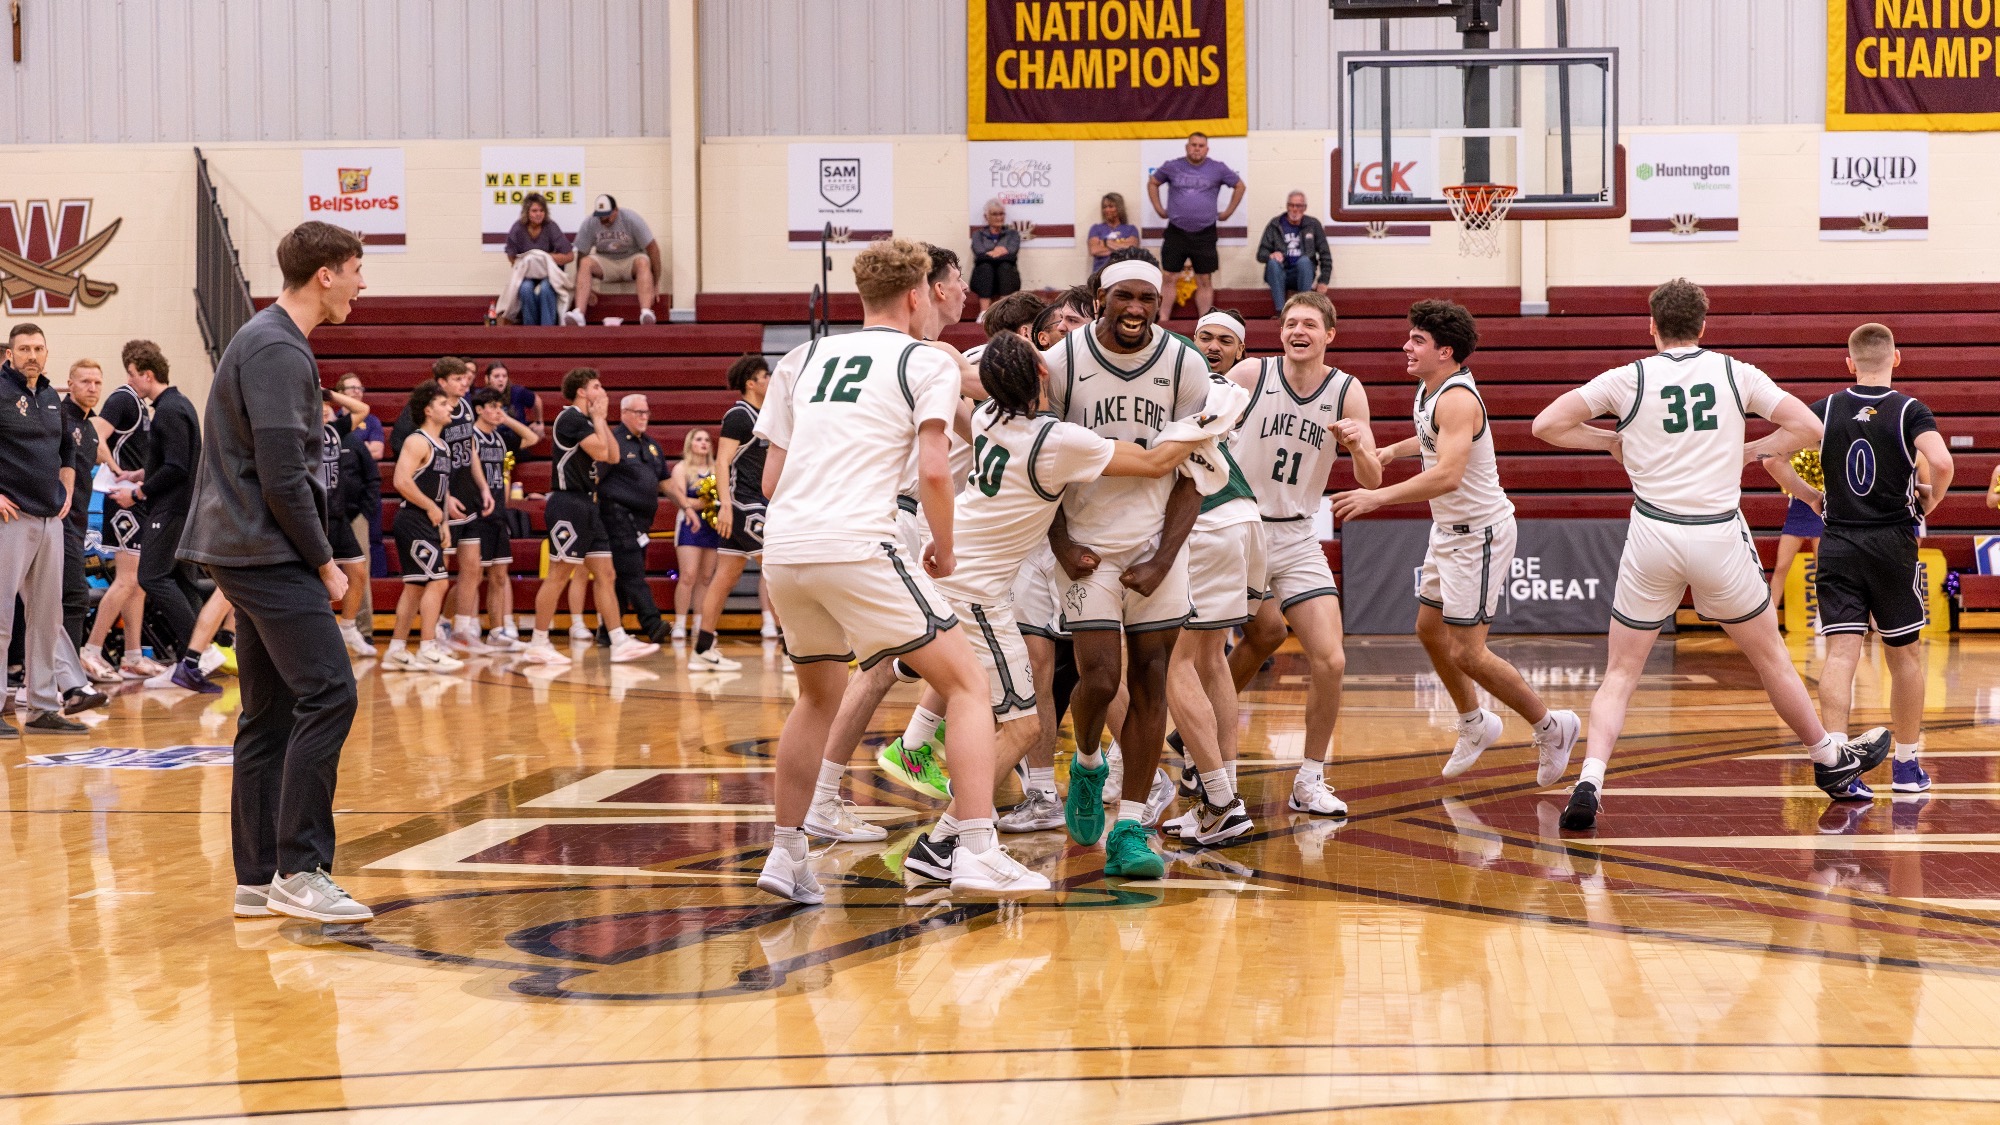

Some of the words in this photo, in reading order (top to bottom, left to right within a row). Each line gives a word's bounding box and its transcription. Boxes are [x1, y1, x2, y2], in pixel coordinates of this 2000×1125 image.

[1015, 0, 1200, 42] NATIONAL
[1875, 0, 2000, 29] NATIO
[995, 45, 1220, 89] CHAMPIONS
[486, 174, 579, 185] WAFFLE
[824, 166, 856, 177] SAM
[991, 170, 1051, 188] FLOORS
[1656, 163, 1730, 180] Huntington
[1831, 156, 1916, 187] LIQUID
[495, 191, 572, 203] HOSE
[809, 355, 873, 403] 12
[1084, 396, 1127, 430] LAKE
[1135, 397, 1166, 432] ERIE
[1660, 383, 1718, 434] 32
[1260, 413, 1297, 439] LAKE
[1299, 418, 1326, 451] ERIE
[451, 439, 473, 469] 35
[968, 434, 1010, 498] 10
[1271, 447, 1303, 485] 21
[1846, 438, 1876, 496] 0
[1511, 556, 1541, 579] BE
[1510, 578, 1600, 600] GREAT
